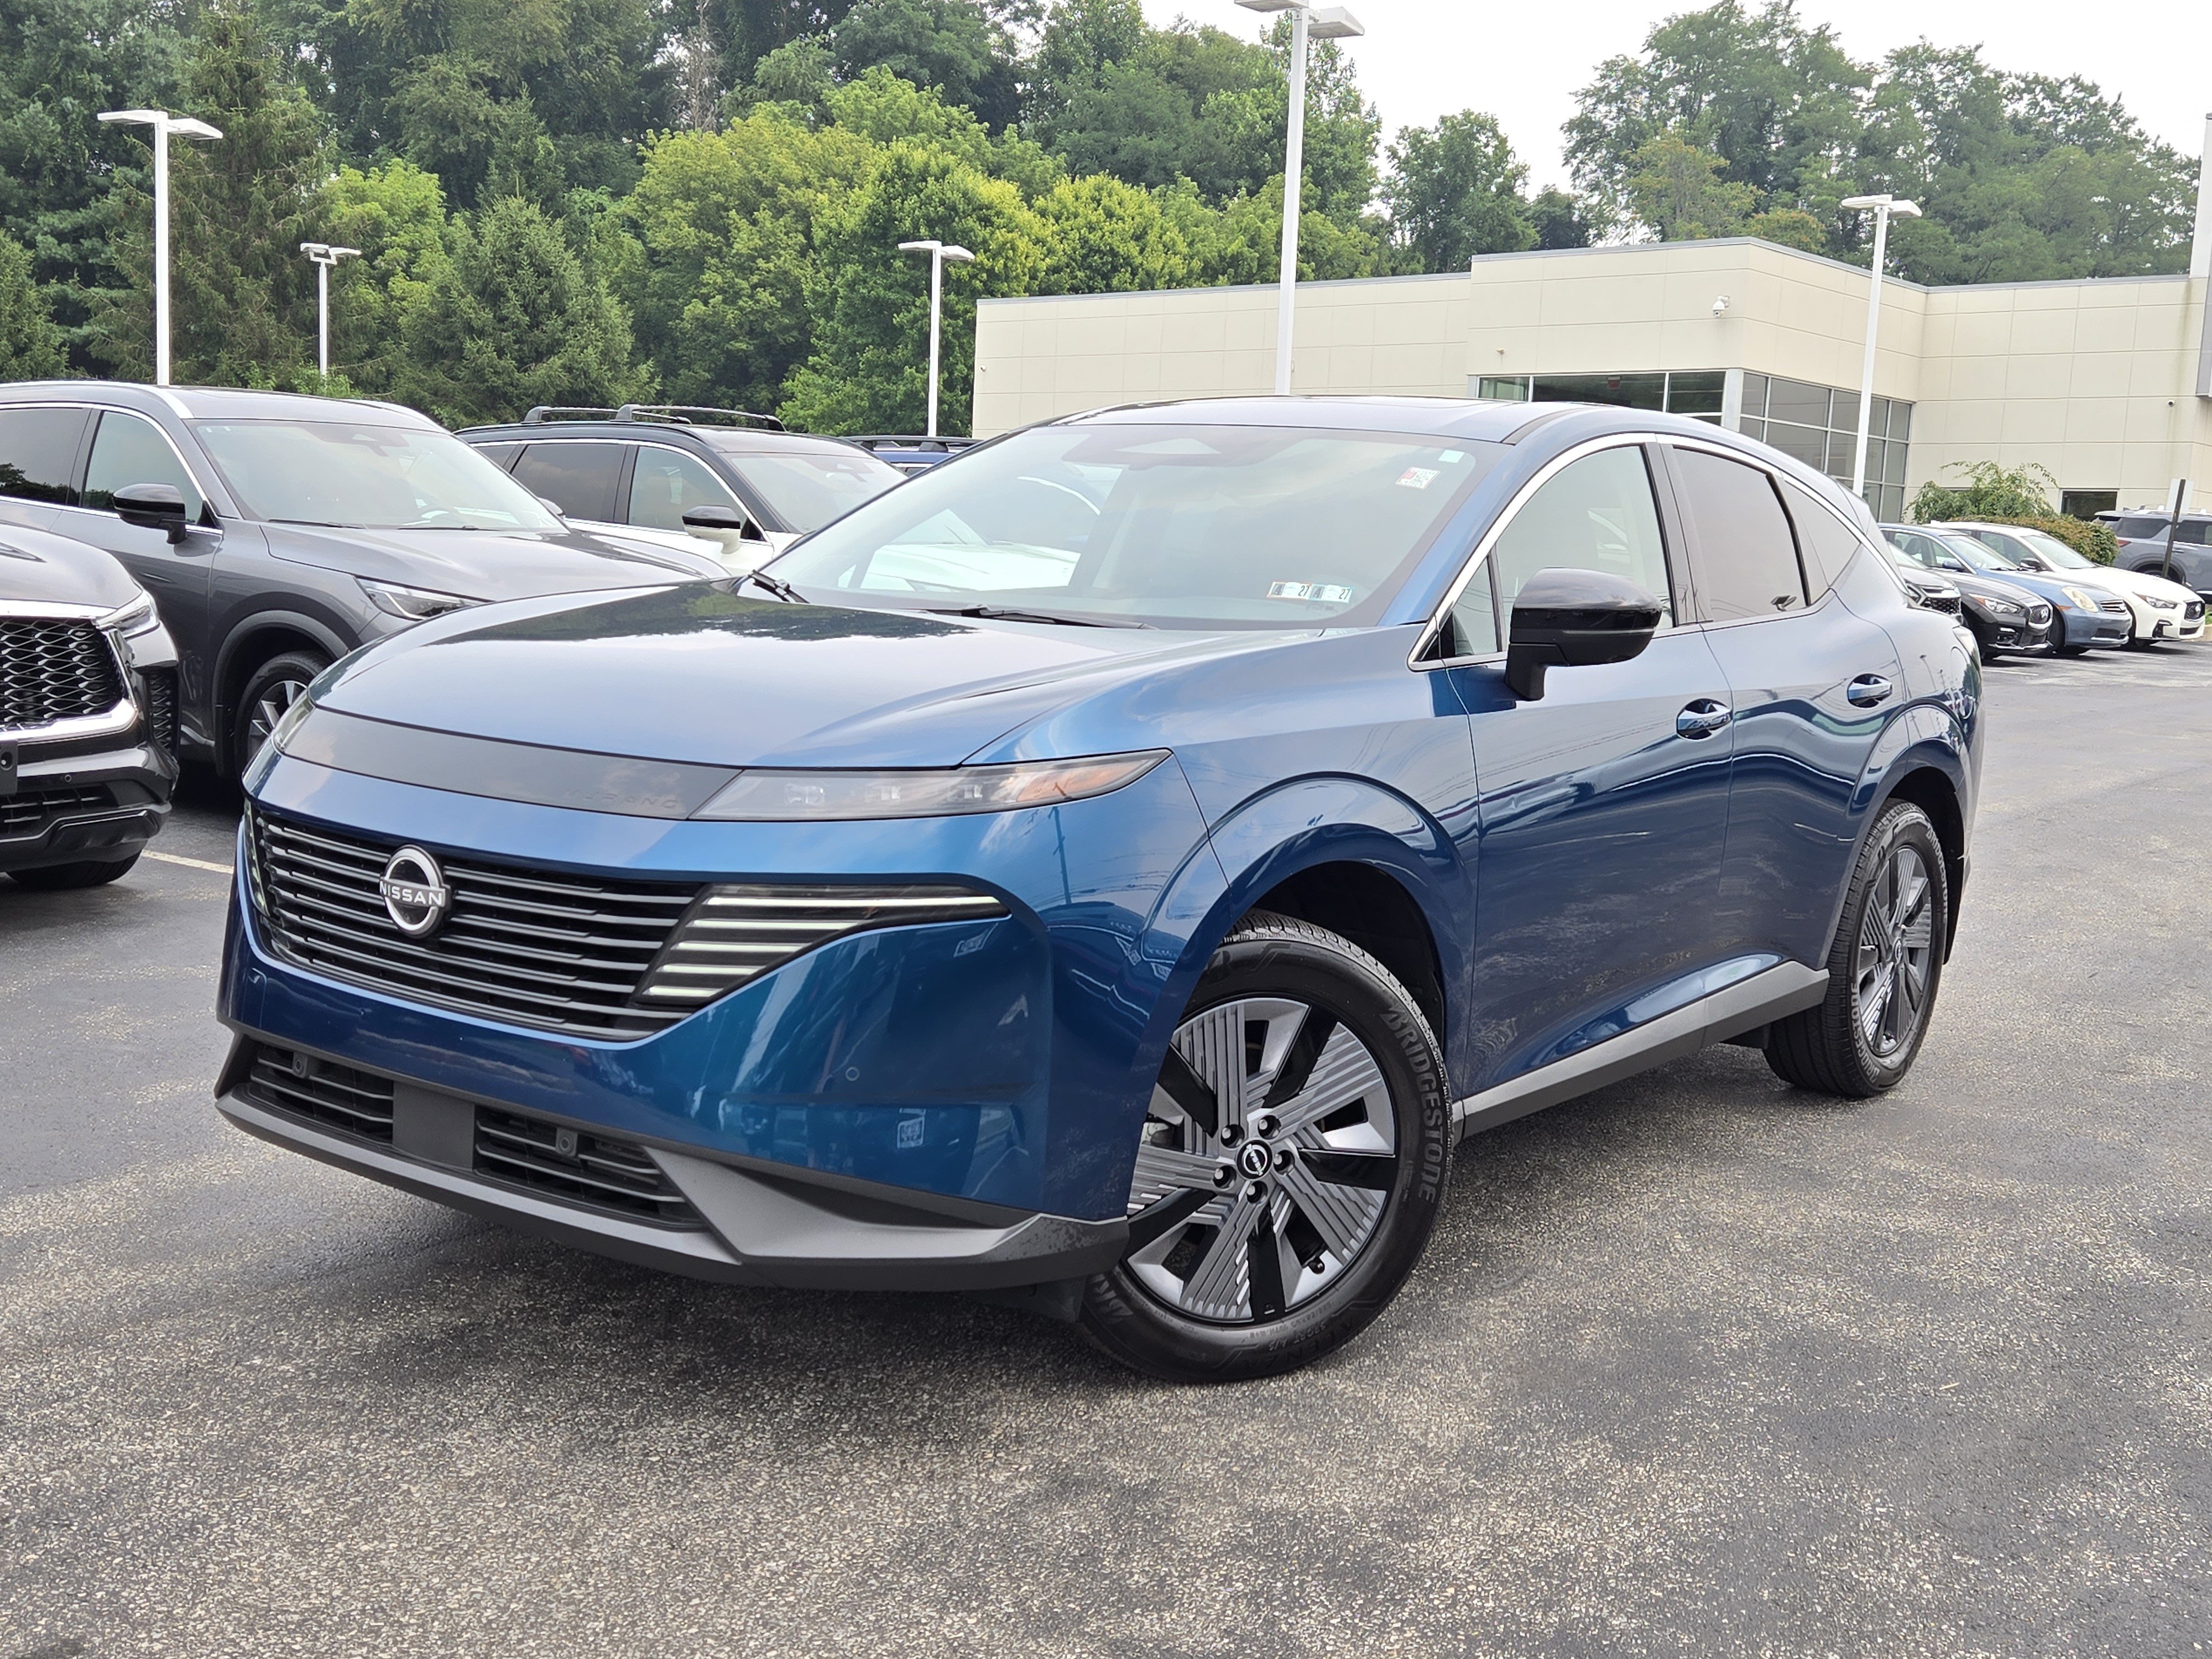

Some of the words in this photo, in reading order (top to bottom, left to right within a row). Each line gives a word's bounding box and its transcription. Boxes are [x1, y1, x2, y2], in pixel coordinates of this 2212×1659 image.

[1298, 585, 1311, 597] 27
[1338, 588, 1350, 600] 27
[379, 880, 442, 905] NISSAN
[1379, 1005, 1446, 1203] BRIDGESTONE
